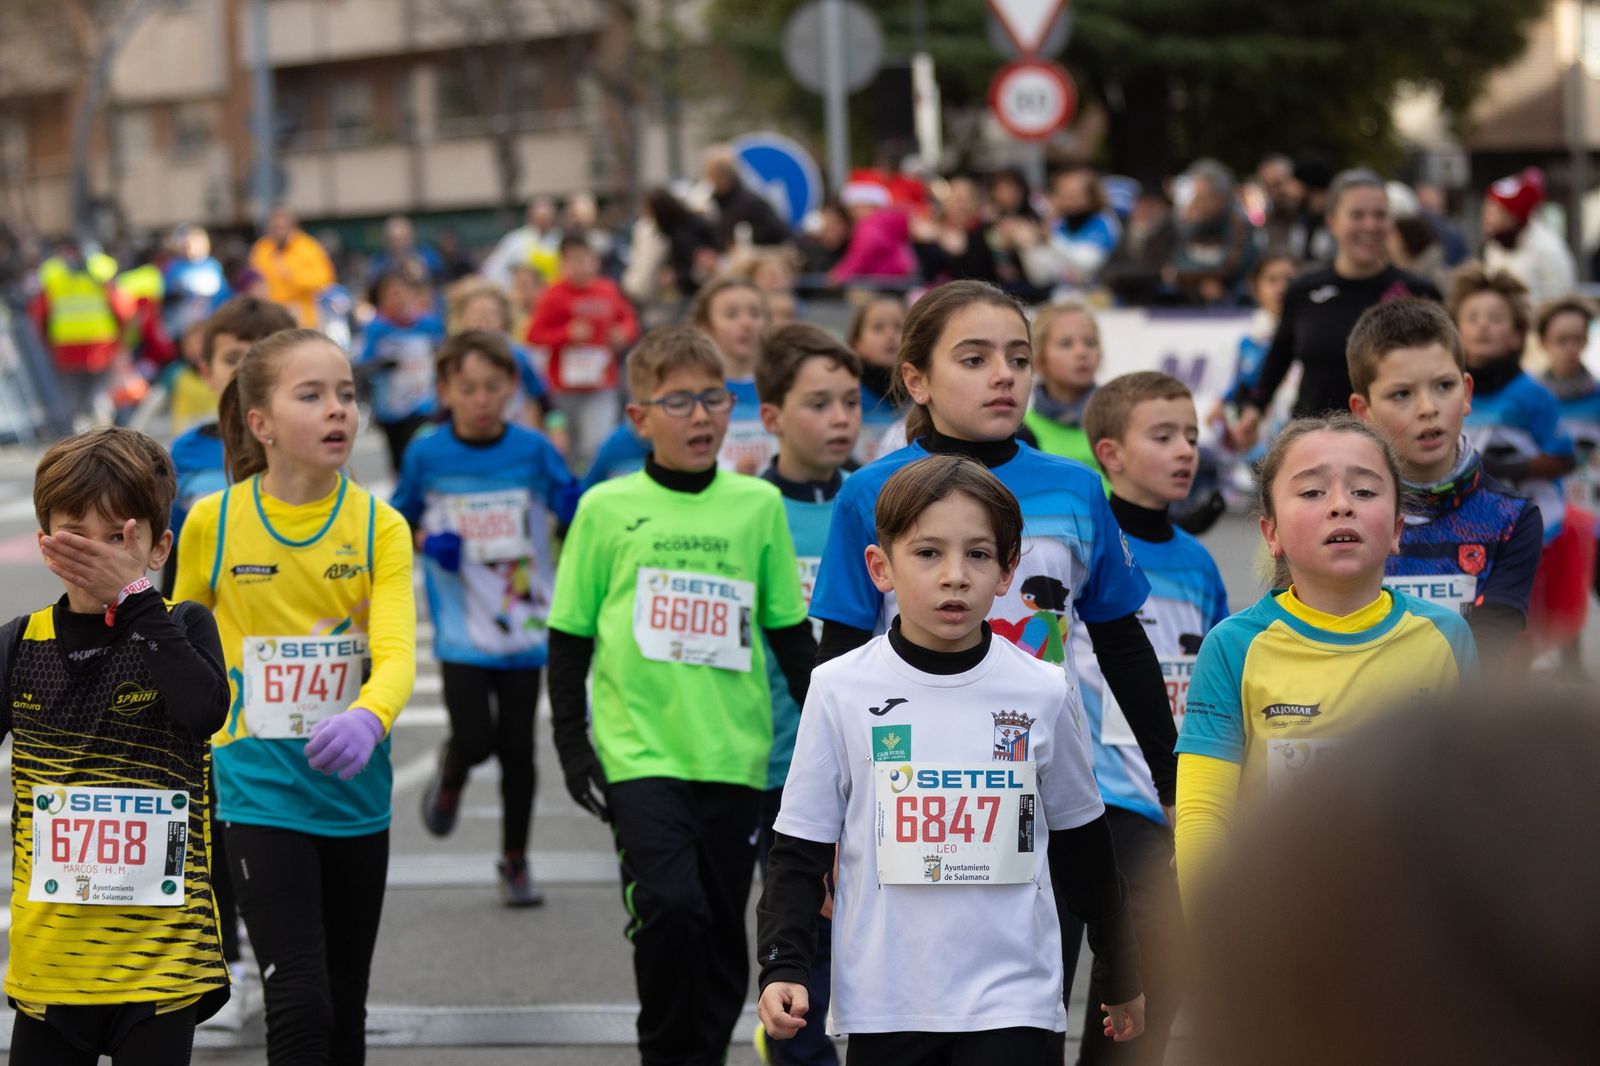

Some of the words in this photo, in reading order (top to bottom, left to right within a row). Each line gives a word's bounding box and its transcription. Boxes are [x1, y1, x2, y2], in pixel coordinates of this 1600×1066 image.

[671, 578, 742, 601] SETEL
[650, 595, 729, 637] 6608
[281, 639, 366, 659] SETEL
[264, 662, 348, 703] 6747
[116, 691, 159, 704] SPRINT
[13, 701, 42, 711] amura
[1269, 705, 1313, 715] ALJOMAR
[917, 770, 1024, 789] SETEL
[70, 793, 172, 815] SETEL
[896, 796, 1001, 843] 6847
[51, 818, 147, 866] 6768
[936, 844, 958, 854] LEO
[63, 864, 99, 874] MARCOS
[944, 864, 990, 872] Ayuntamiento
[944, 873, 953, 881] de
[954, 873, 990, 881] Salamanca
[92, 884, 135, 892] Ayuntamiento
[92, 892, 99, 900] de
